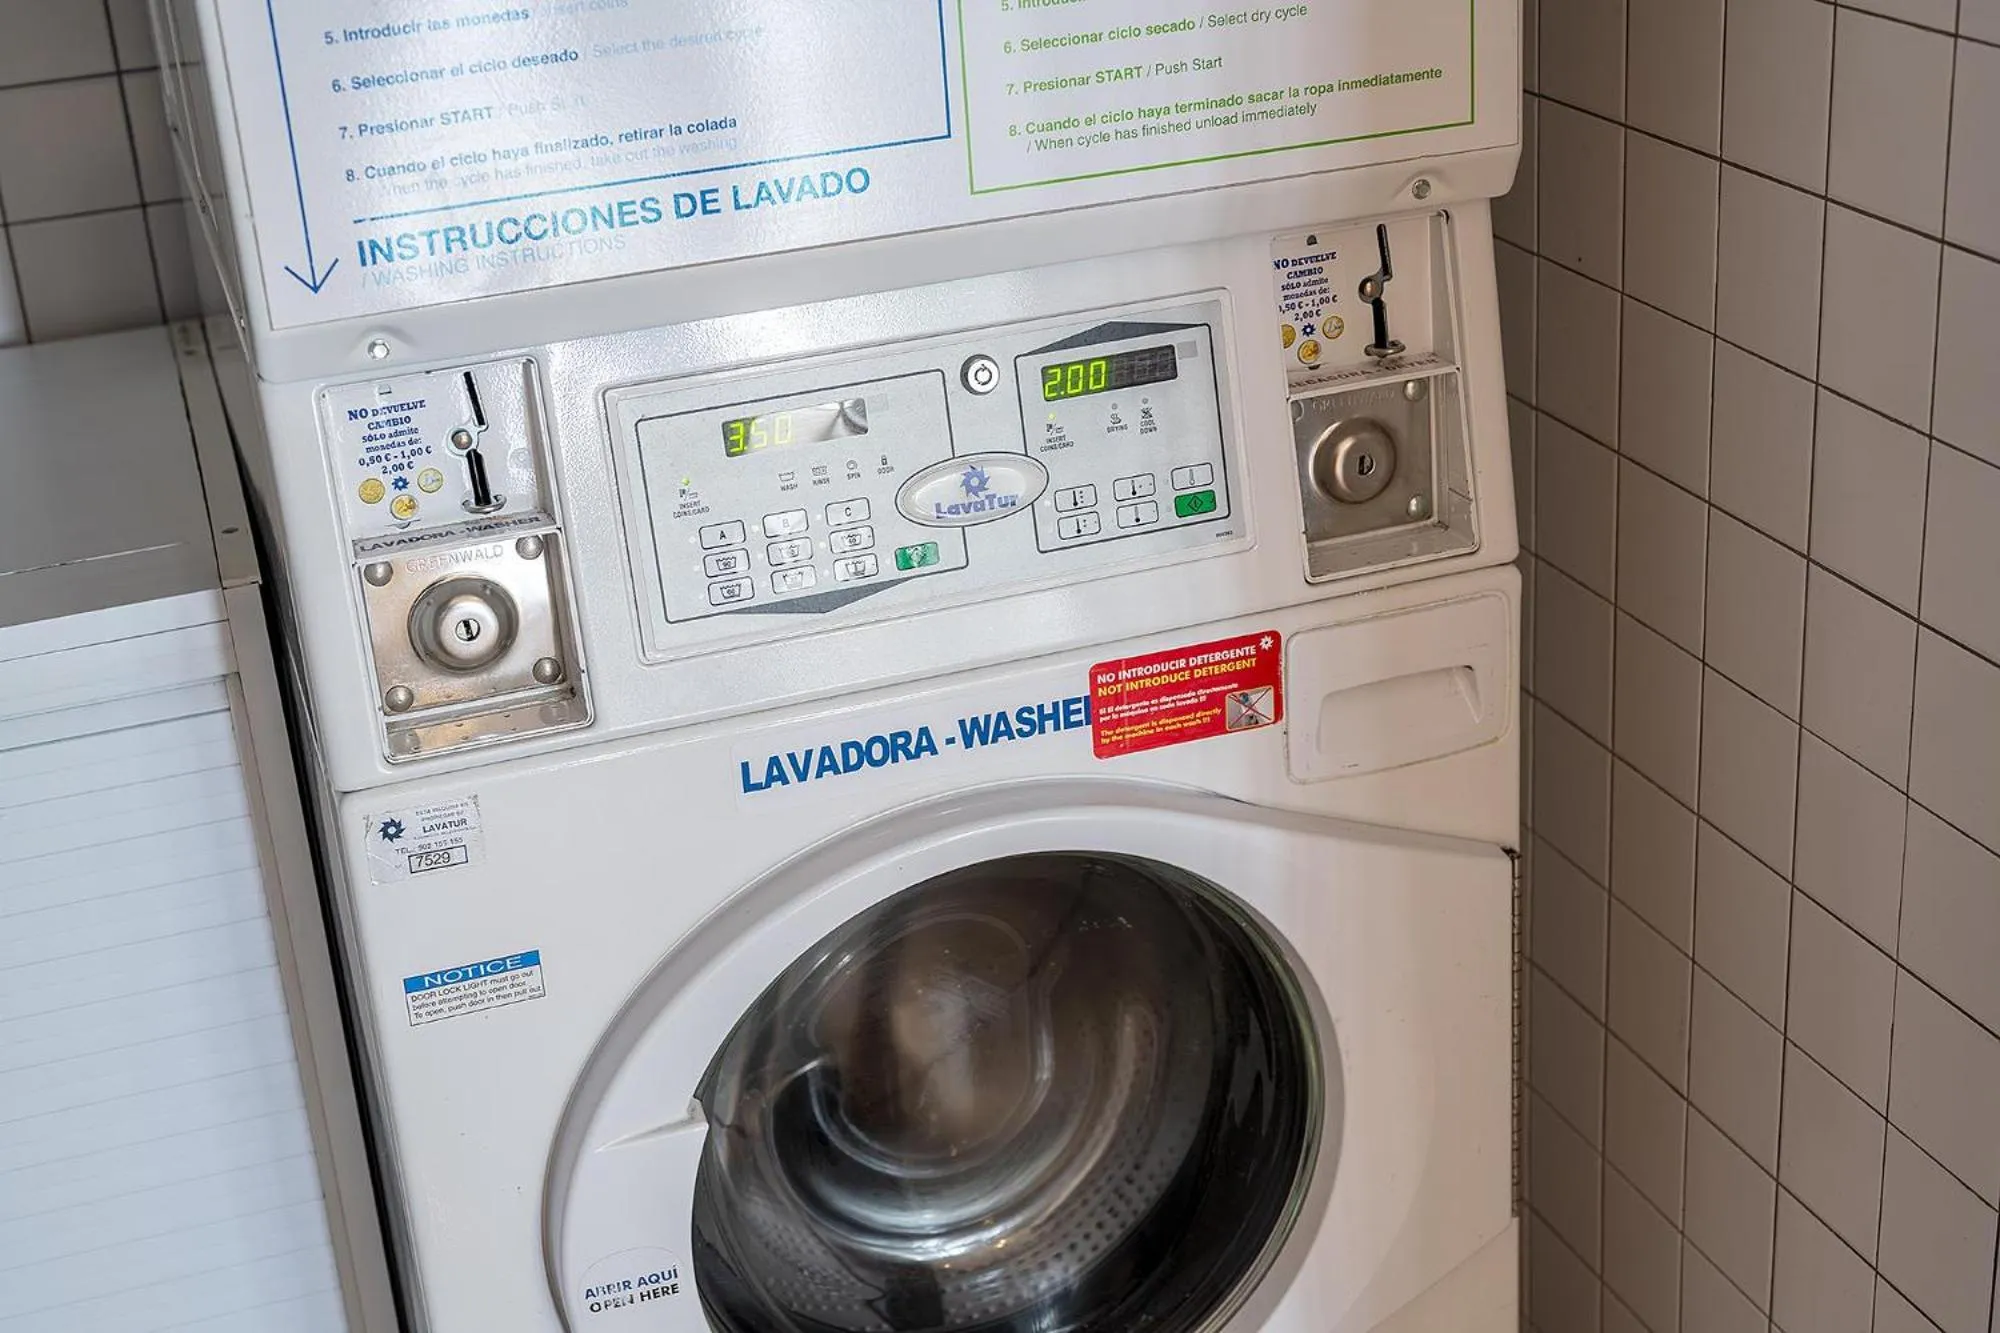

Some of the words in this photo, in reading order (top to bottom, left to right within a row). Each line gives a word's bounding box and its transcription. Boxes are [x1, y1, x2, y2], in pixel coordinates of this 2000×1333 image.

[324, 31, 339, 45] 5.
[343, 20, 422, 42] Introducir
[456, 8, 530, 28] monedas
[1004, 41, 1016, 54] 6.
[1020, 32, 1104, 52] Seleccionar
[1108, 25, 1141, 41] ciclo
[1146, 19, 1196, 35] secado
[1207, 12, 1248, 28] Select
[1251, 8, 1271, 24] dry
[1275, 4, 1308, 22] cycle
[332, 78, 347, 93] 6.
[350, 67, 447, 90] Seleccionar
[450, 64, 464, 77] el
[469, 59, 507, 74] ciclo
[512, 49, 579, 69] deseado
[1006, 84, 1018, 95] 7.
[1023, 75, 1091, 93] Presionar
[1096, 66, 1143, 84] START
[1155, 60, 1188, 76] Push
[1192, 56, 1223, 70] Start
[1009, 125, 1021, 137] 8.
[1025, 117, 1080, 134] Cuando
[1084, 113, 1097, 126] el
[1101, 109, 1134, 124] ciclo
[1138, 105, 1170, 121] haya
[1175, 94, 1243, 115] terminado
[1247, 90, 1285, 105] sacar
[1289, 86, 1300, 98] la
[1304, 81, 1334, 97] ropa
[1338, 67, 1443, 92] inmediatamente
[338, 126, 353, 139] 7.
[359, 116, 435, 137] Presionar
[440, 106, 494, 126] START
[1035, 136, 1073, 152] When
[1077, 131, 1111, 149] cycle
[1115, 128, 1139, 140] has
[1142, 120, 1192, 137] finished
[1195, 112, 1239, 129] unload
[1242, 102, 1318, 123] immediately
[345, 169, 360, 183] 8.
[364, 159, 426, 180] Cuando
[431, 156, 446, 170] el
[450, 151, 488, 167] ciclo
[492, 145, 530, 162] haya
[534, 134, 614, 154] finalizado,
[618, 125, 664, 144] retirar
[669, 124, 682, 137] la
[687, 116, 738, 134] colada
[679, 137, 738, 156] washing
[356, 196, 662, 268] INSTRUCCIONES
[673, 187, 721, 221] DE
[731, 166, 871, 211] LAVADO
[370, 258, 470, 289] WASHING
[475, 235, 626, 271] INSTRUCTIONS
[1273, 258, 1289, 270] NO
[1291, 251, 1337, 267] DEVUELVE
[1287, 266, 1324, 280] CAMBIO
[1312, 296, 1330, 308] 1,00
[1295, 310, 1314, 321] 2,00
[1044, 360, 1107, 397] 2.00
[347, 408, 368, 421] NO
[371, 399, 426, 417] DEVUELVE
[367, 415, 412, 430] CAMBIO
[388, 426, 419, 439] admite
[358, 455, 382, 467] 0,50
[401, 447, 423, 460] 1,00
[366, 441, 406, 453] monedas
[381, 463, 405, 475] 2,00
[844, 507, 852, 517] C
[935, 493, 1018, 517] LavaTur
[360, 530, 456, 552] LAVADORA
[719, 530, 727, 540] A
[406, 544, 504, 572] GREENWALD
[1097, 672, 1116, 684] NO
[1118, 657, 1186, 681] INTRODUCIR
[1190, 645, 1257, 667] DETERGENTE
[1098, 681, 1123, 697] NOT
[1126, 667, 1190, 691] INTRODUCE
[1194, 657, 1257, 678] DETERGENT
[741, 726, 938, 794] LAVADORA
[422, 818, 468, 834] LAVATUR
[415, 851, 450, 868] 7529
[424, 956, 523, 988] NOTICE
[411, 991, 437, 1002] DOOR
[438, 986, 461, 996] LOCK
[463, 979, 488, 991] LIGHT
[490, 975, 508, 985] must
[510, 974, 520, 983] go
[521, 970, 533, 978] out
[479, 989, 487, 997] to
[488, 985, 507, 996] open
[509, 981, 526, 990] door
[415, 1011, 423, 1019] To
[448, 1002, 467, 1012] push
[468, 998, 485, 1008] door
[496, 992, 513, 1001] then
[514, 988, 527, 998] pull
[528, 986, 541, 994] out
[637, 1264, 678, 1288] AQUÍ
[589, 1294, 635, 1313] OPEN
[640, 1283, 680, 1302] HERE
